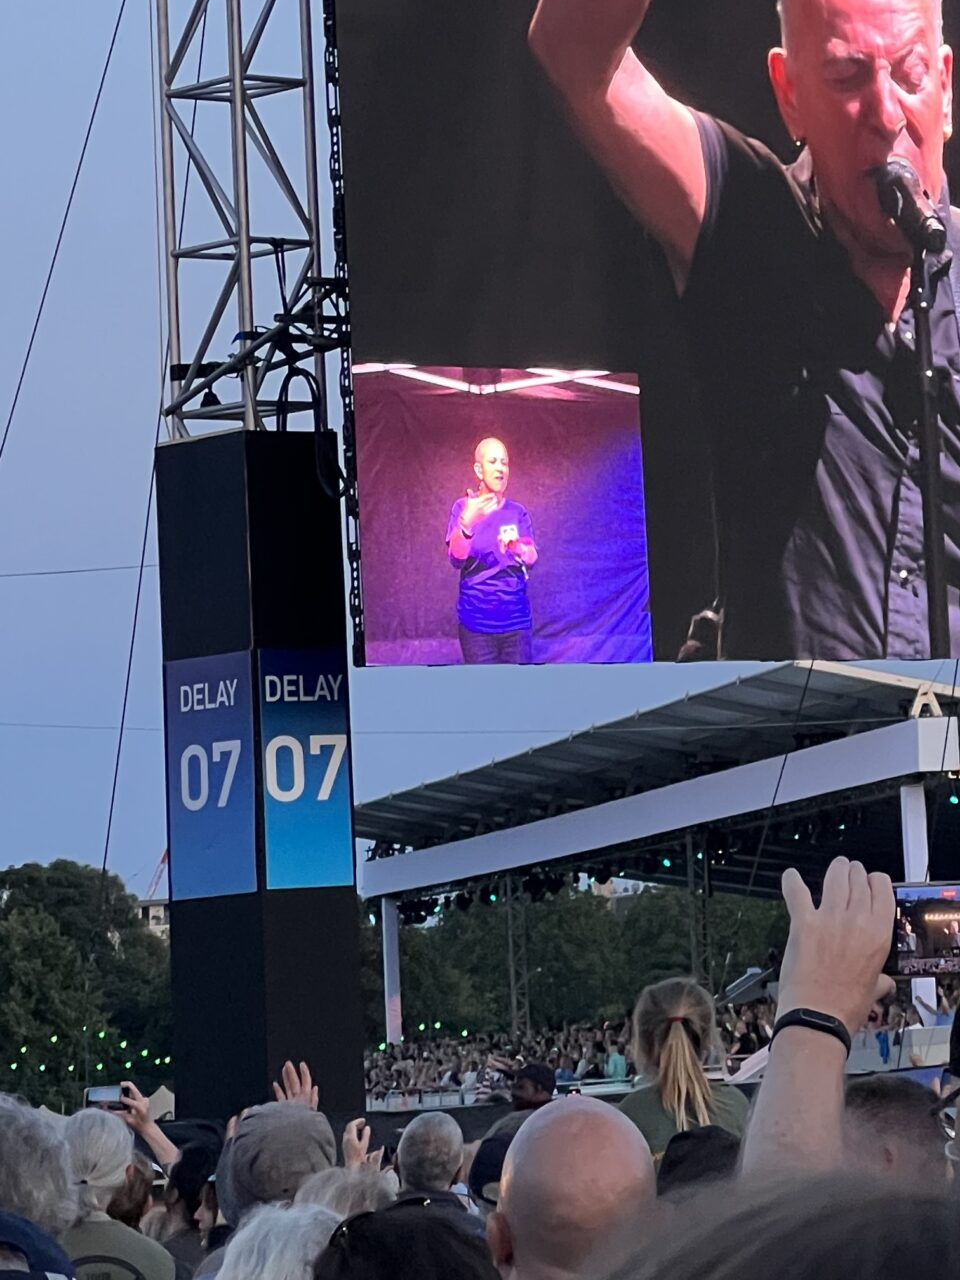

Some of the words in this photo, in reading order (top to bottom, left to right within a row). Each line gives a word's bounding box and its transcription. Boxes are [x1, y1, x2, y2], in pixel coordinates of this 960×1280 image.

[180, 678, 238, 712] DELAY
[264, 674, 343, 703] DELAY
[180, 739, 241, 812] 07
[265, 734, 347, 802] 07
